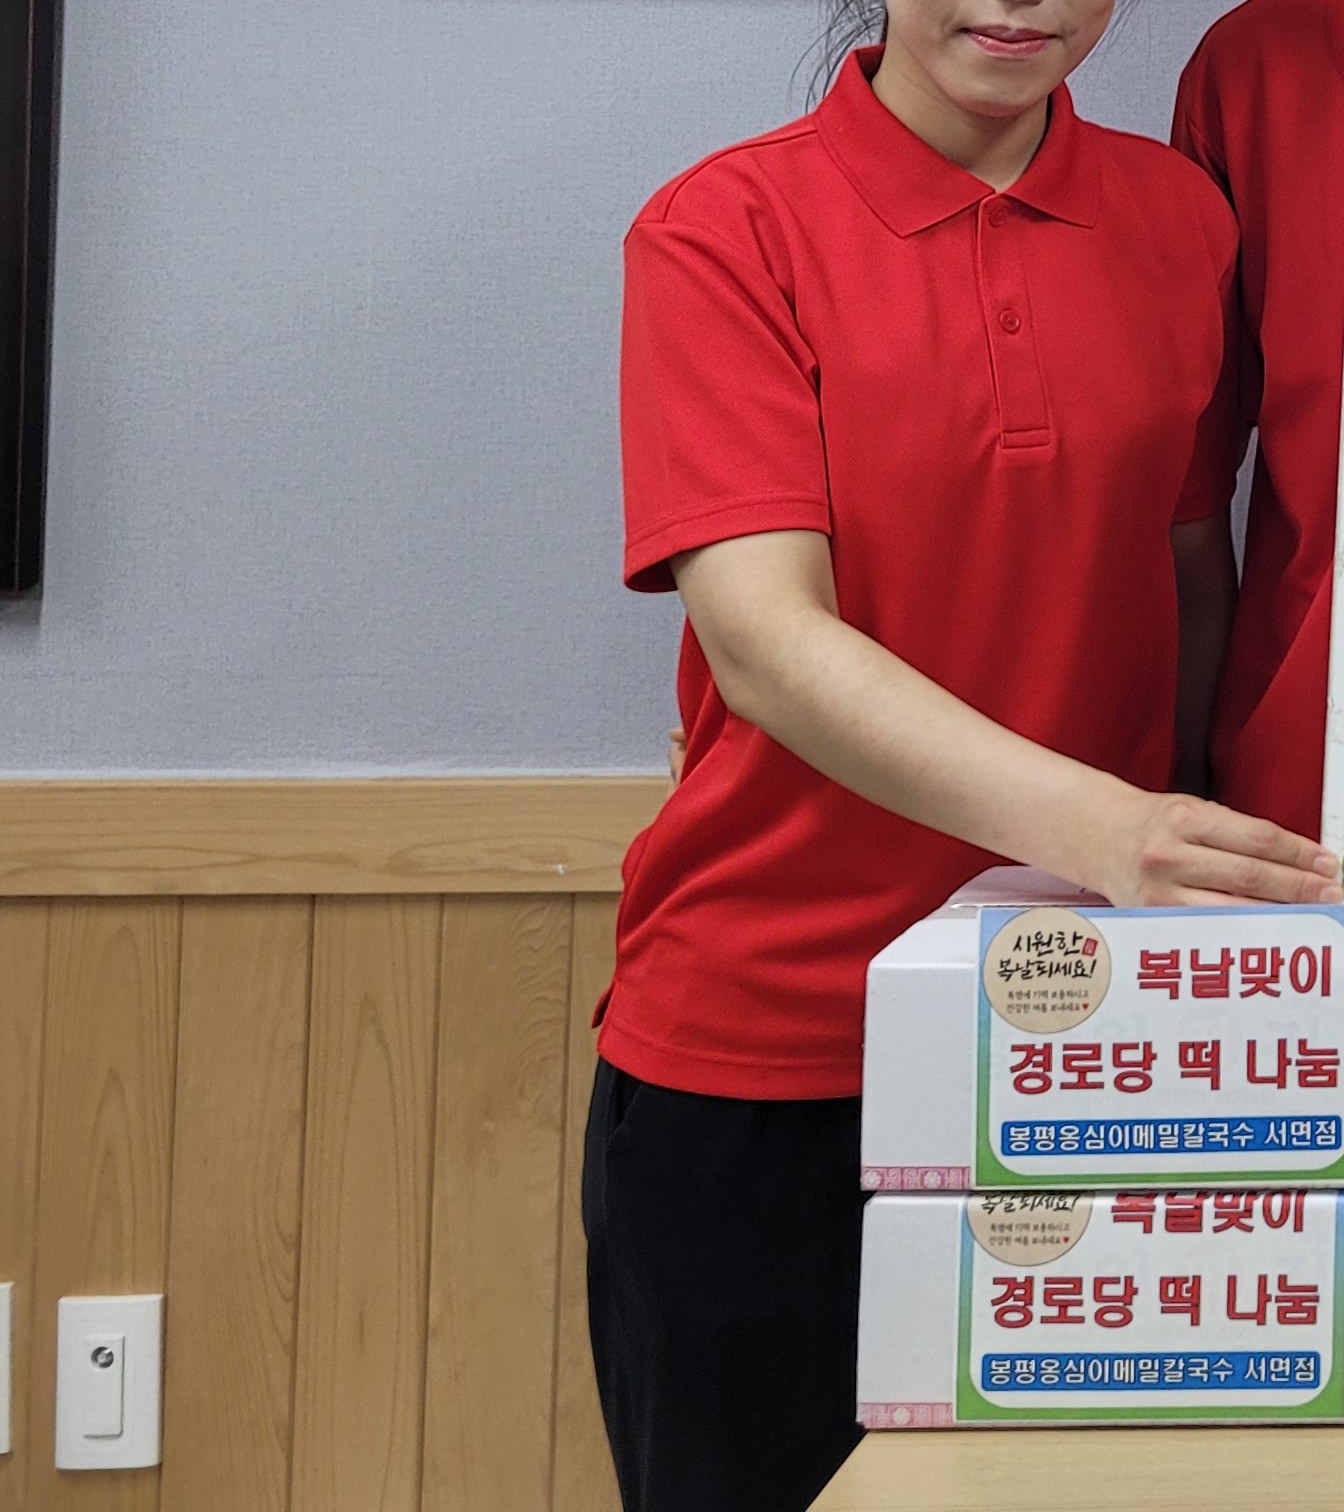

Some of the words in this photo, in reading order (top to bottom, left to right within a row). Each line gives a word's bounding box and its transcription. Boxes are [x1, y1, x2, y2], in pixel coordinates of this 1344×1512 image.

[1137, 941, 1331, 1002] 복날맞이
[1010, 1041, 1157, 1094] 경로당
[1178, 1040, 1220, 1090] 떡
[1246, 1038, 1340, 1089] 나눔
[1010, 1122, 1253, 1151] 봉평옹심이메밀칼국수
[1265, 1120, 1341, 1149] 서면점
